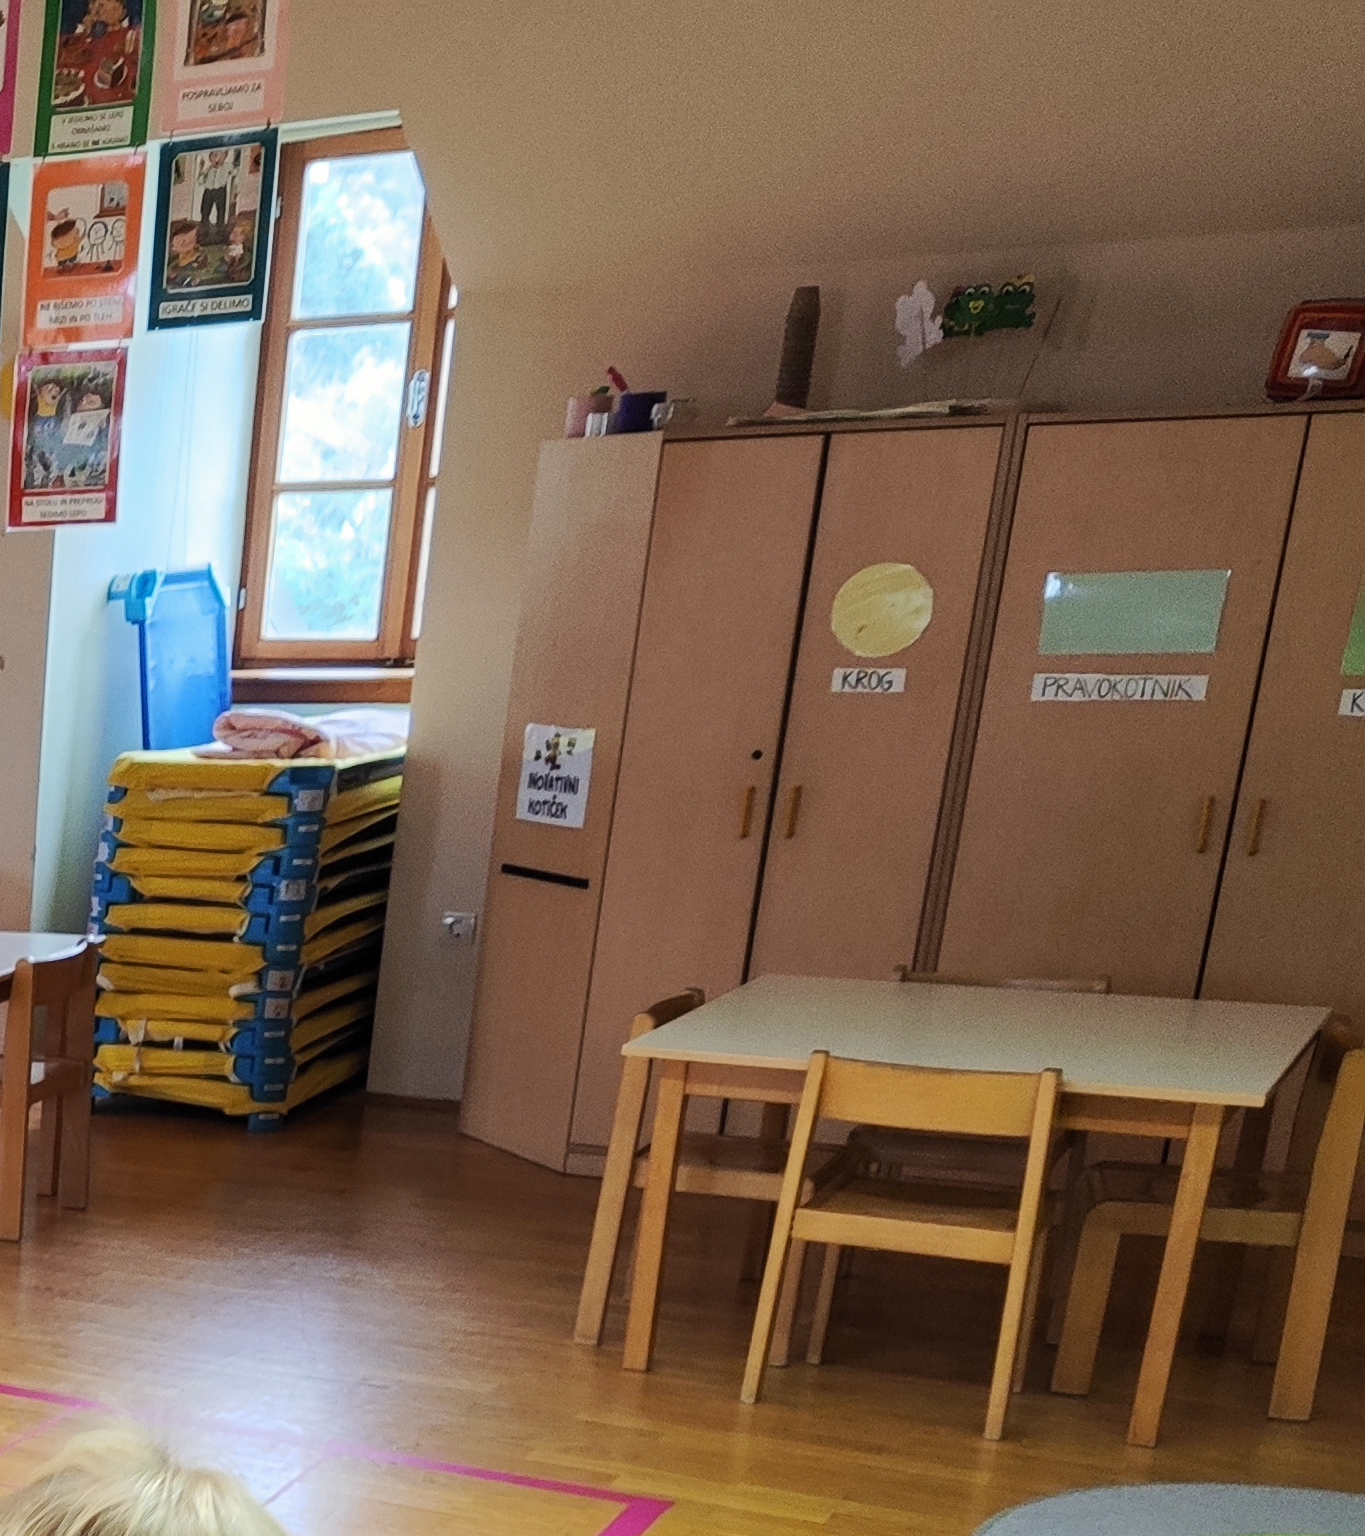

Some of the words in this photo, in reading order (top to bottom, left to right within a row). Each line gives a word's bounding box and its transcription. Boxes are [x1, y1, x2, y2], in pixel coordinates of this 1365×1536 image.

[161, 299, 196, 315] IGRAČE
[210, 296, 250, 311] DELIMO
[841, 669, 895, 692] KROG
[1040, 675, 1193, 700] PRAVOKOTNIK
[527, 794, 569, 820] KOTIČEK
